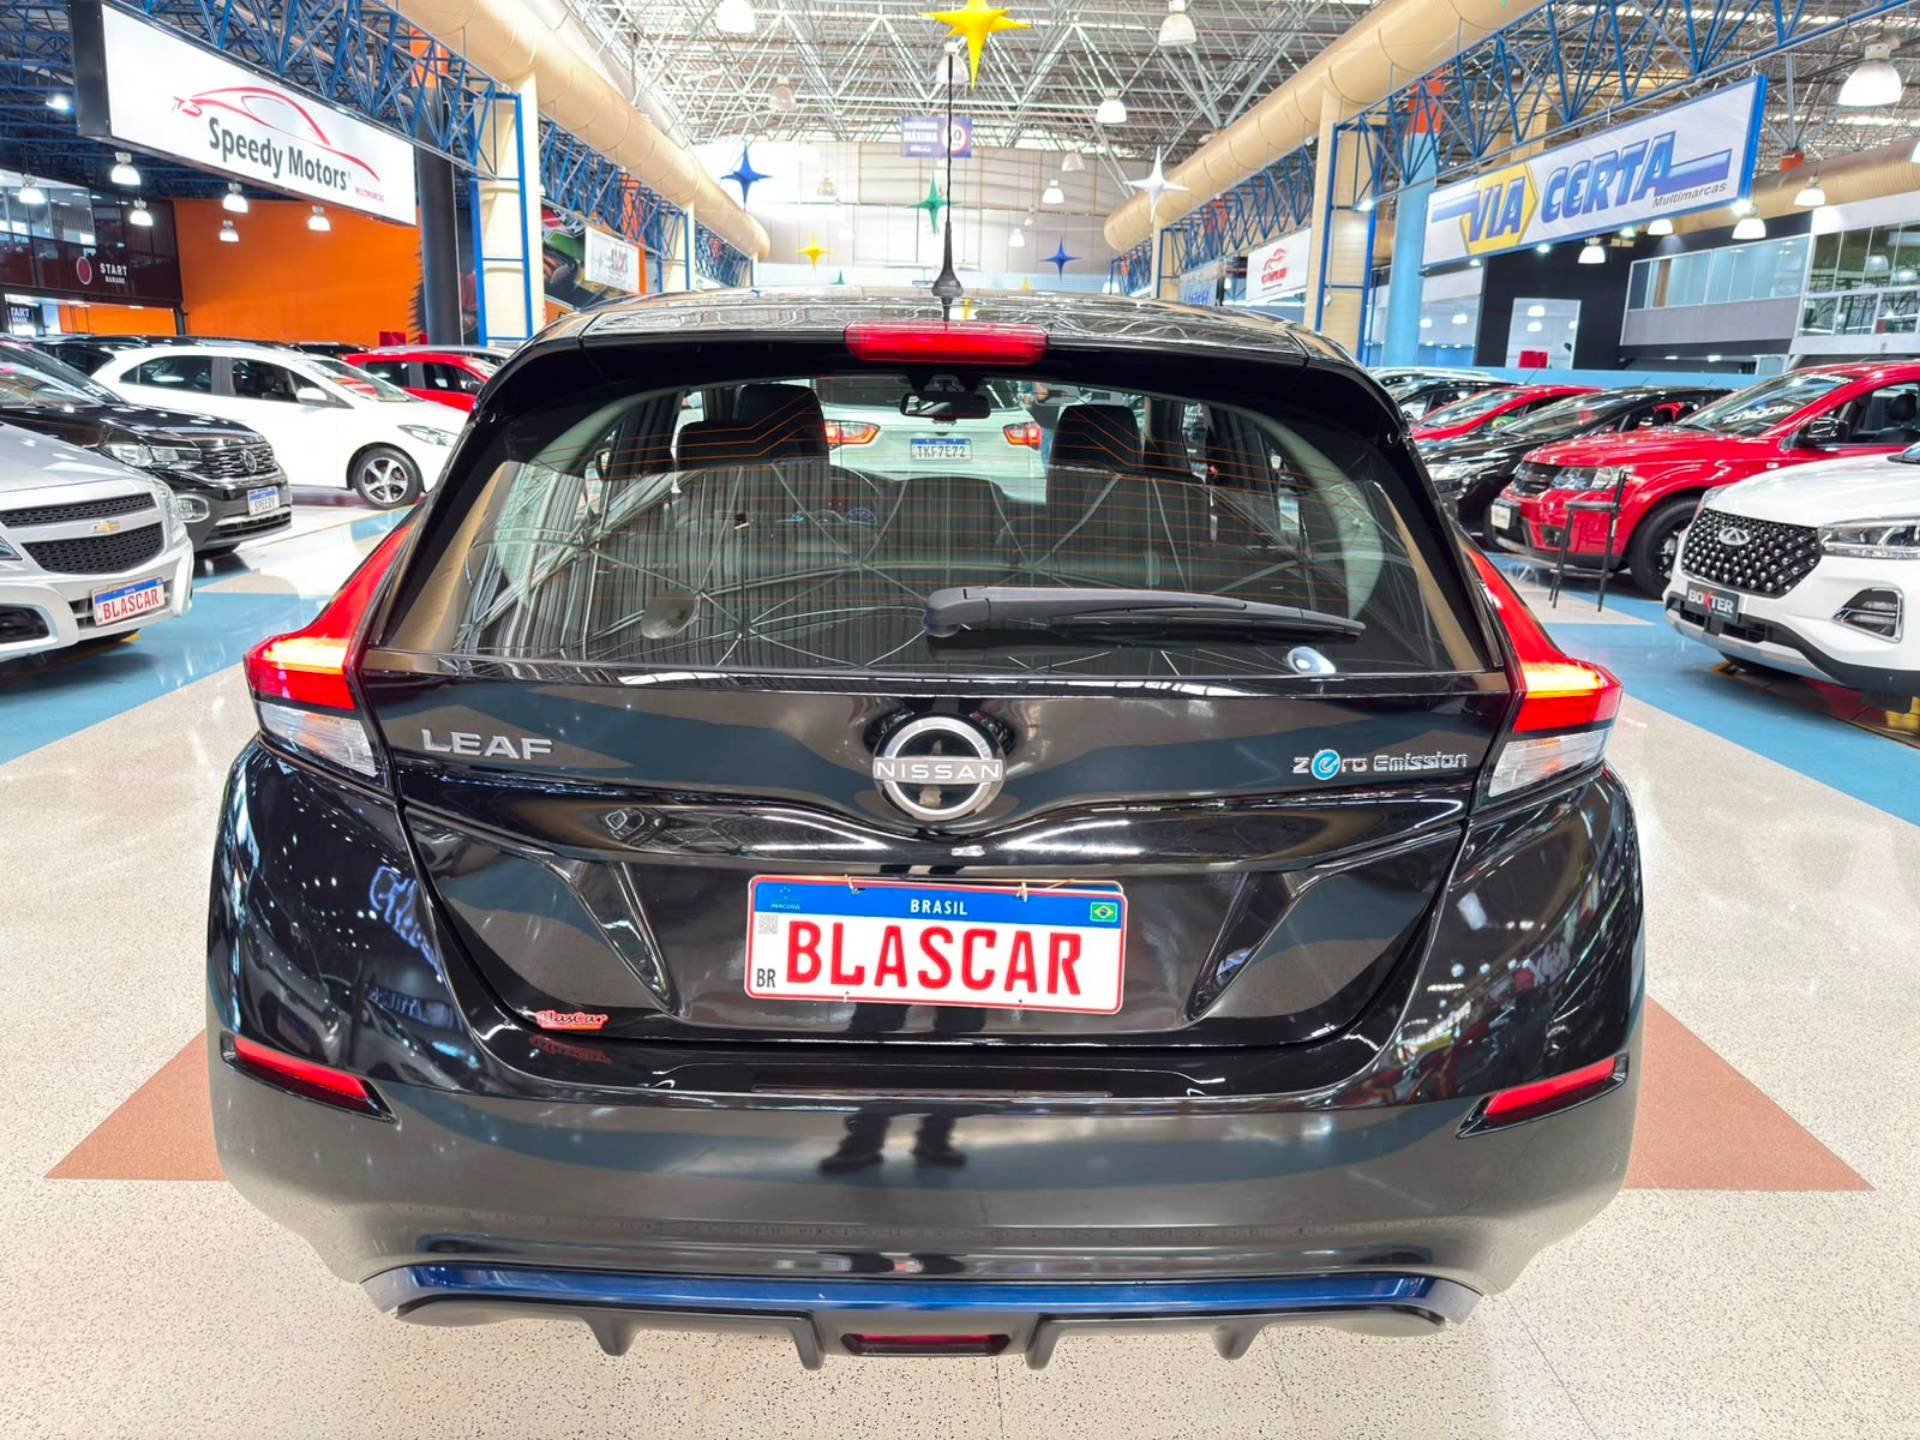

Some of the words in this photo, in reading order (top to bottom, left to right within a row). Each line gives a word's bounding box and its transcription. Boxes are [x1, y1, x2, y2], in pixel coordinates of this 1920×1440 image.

[209, 116, 283, 179] Speedy
[288, 146, 347, 191] Motors
[1465, 178, 1525, 242] VIA
[1541, 131, 1676, 223] CERTA
[1652, 182, 1727, 208] Multimarcas
[100, 262, 127, 276] START
[103, 588, 159, 620] BLASCAR
[421, 729, 552, 760] LEAF
[876, 762, 999, 780] NISSAN
[1373, 752, 1468, 772] Emission
[910, 898, 968, 916] BRASIL
[786, 920, 1082, 996] BLASCAR
[756, 968, 776, 989] BR
